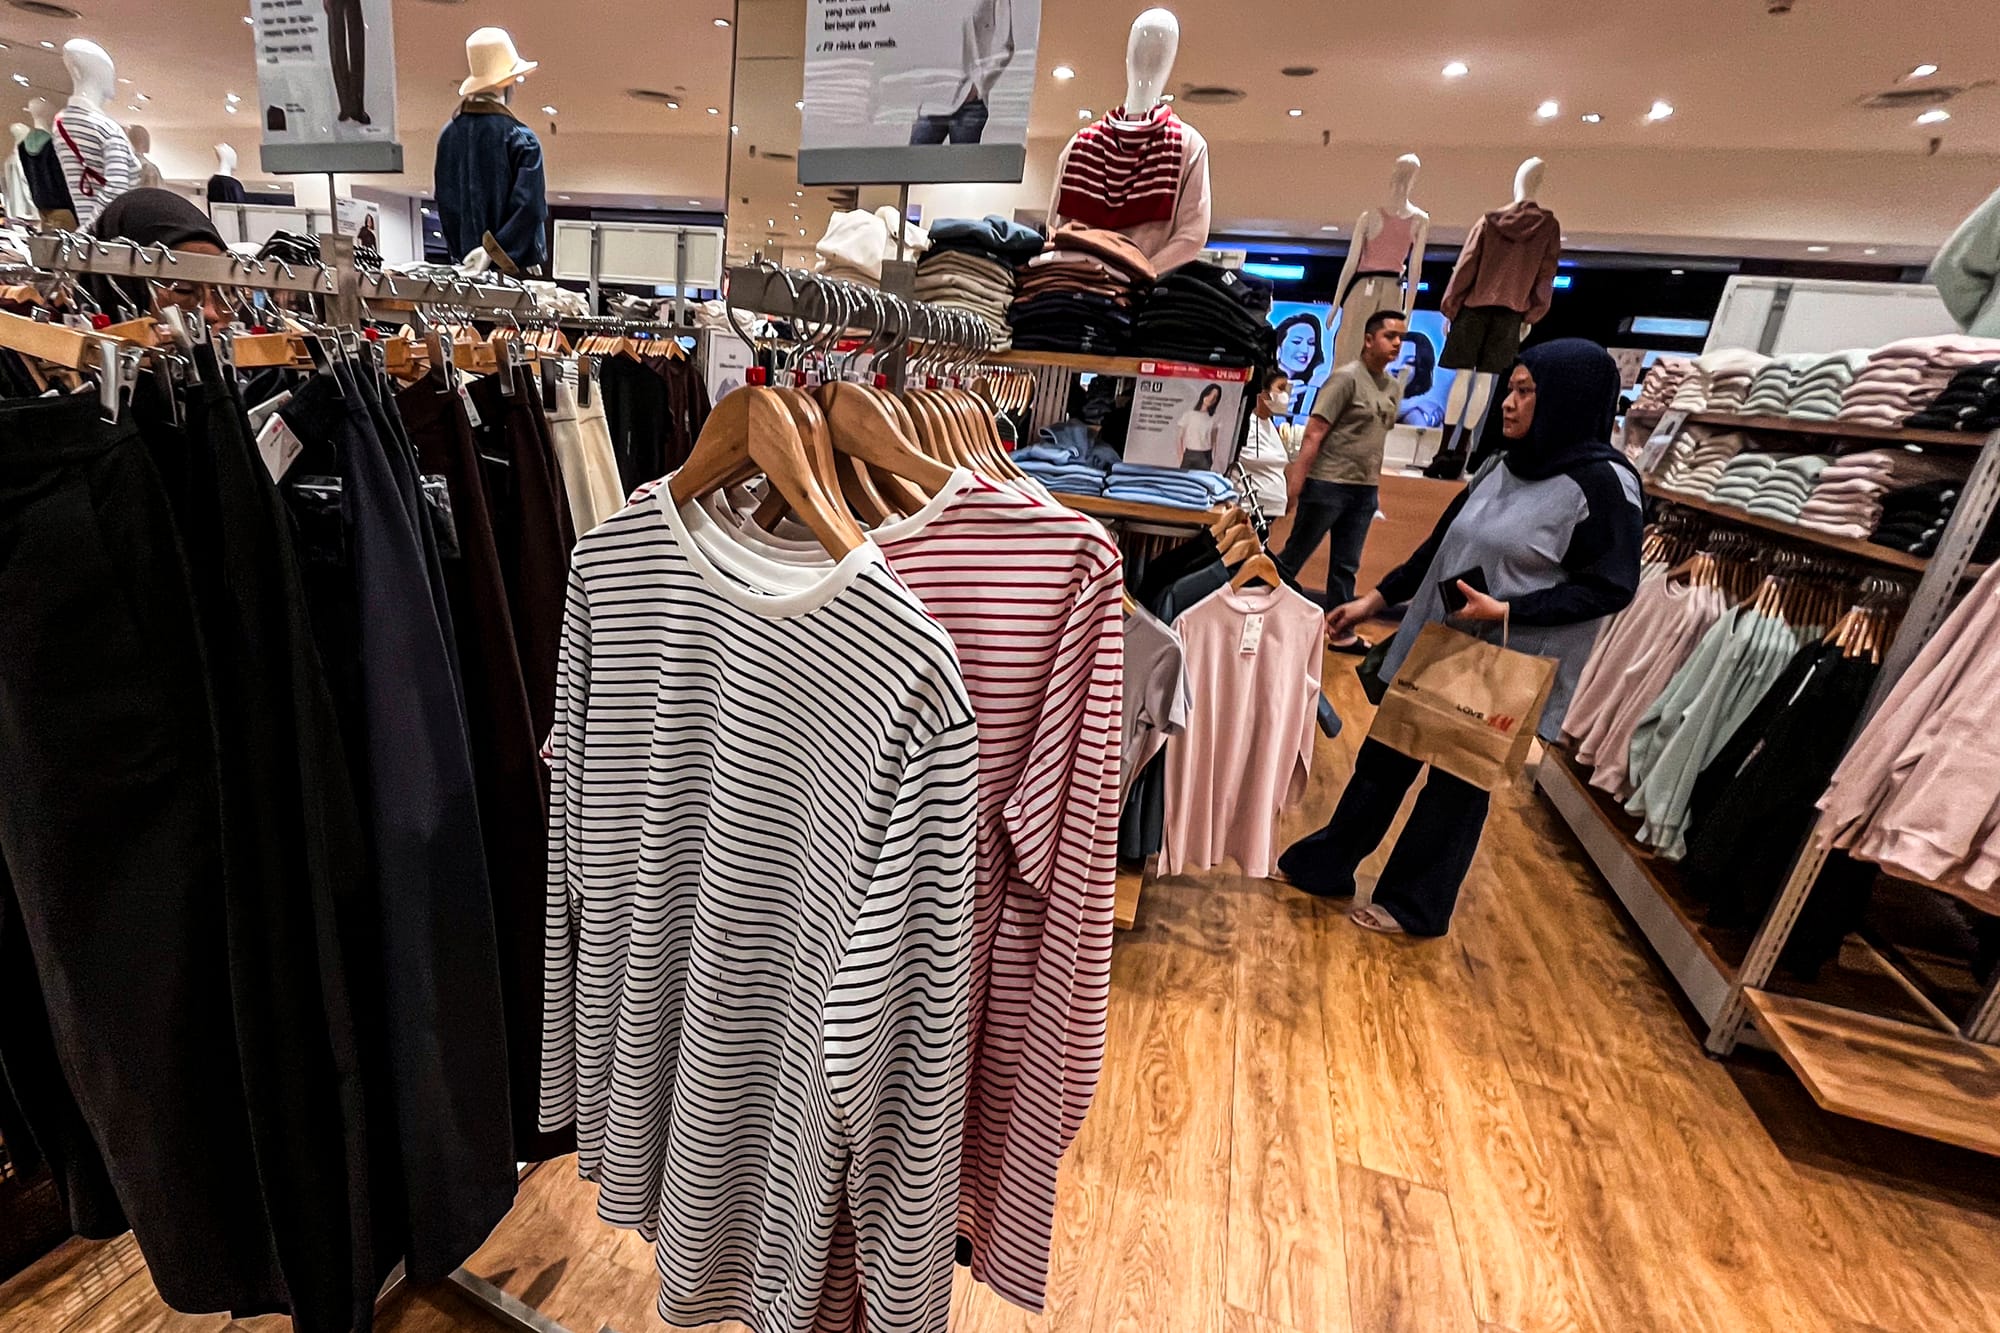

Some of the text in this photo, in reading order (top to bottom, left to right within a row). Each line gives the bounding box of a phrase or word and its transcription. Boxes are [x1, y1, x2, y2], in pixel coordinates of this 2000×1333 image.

[870, 3, 891, 13] untuk
[859, 40, 871, 50] dan
[1457, 704, 1484, 719] LOVE
